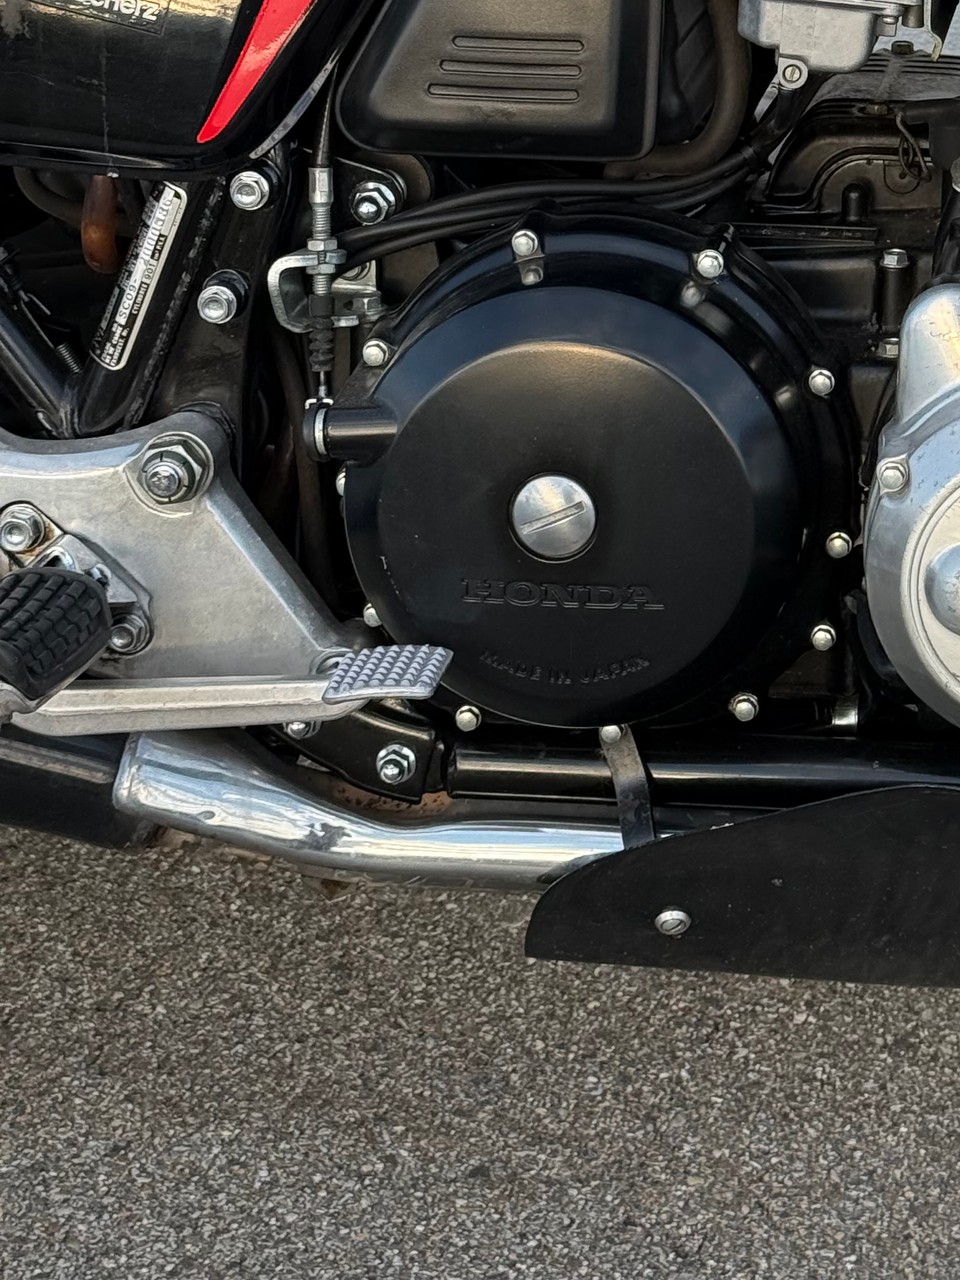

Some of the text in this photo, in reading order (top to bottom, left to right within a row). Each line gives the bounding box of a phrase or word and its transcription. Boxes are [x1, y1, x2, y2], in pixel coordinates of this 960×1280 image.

[460, 578, 665, 610] HONDA
[479, 650, 650, 685] MADE IN JAPAN
